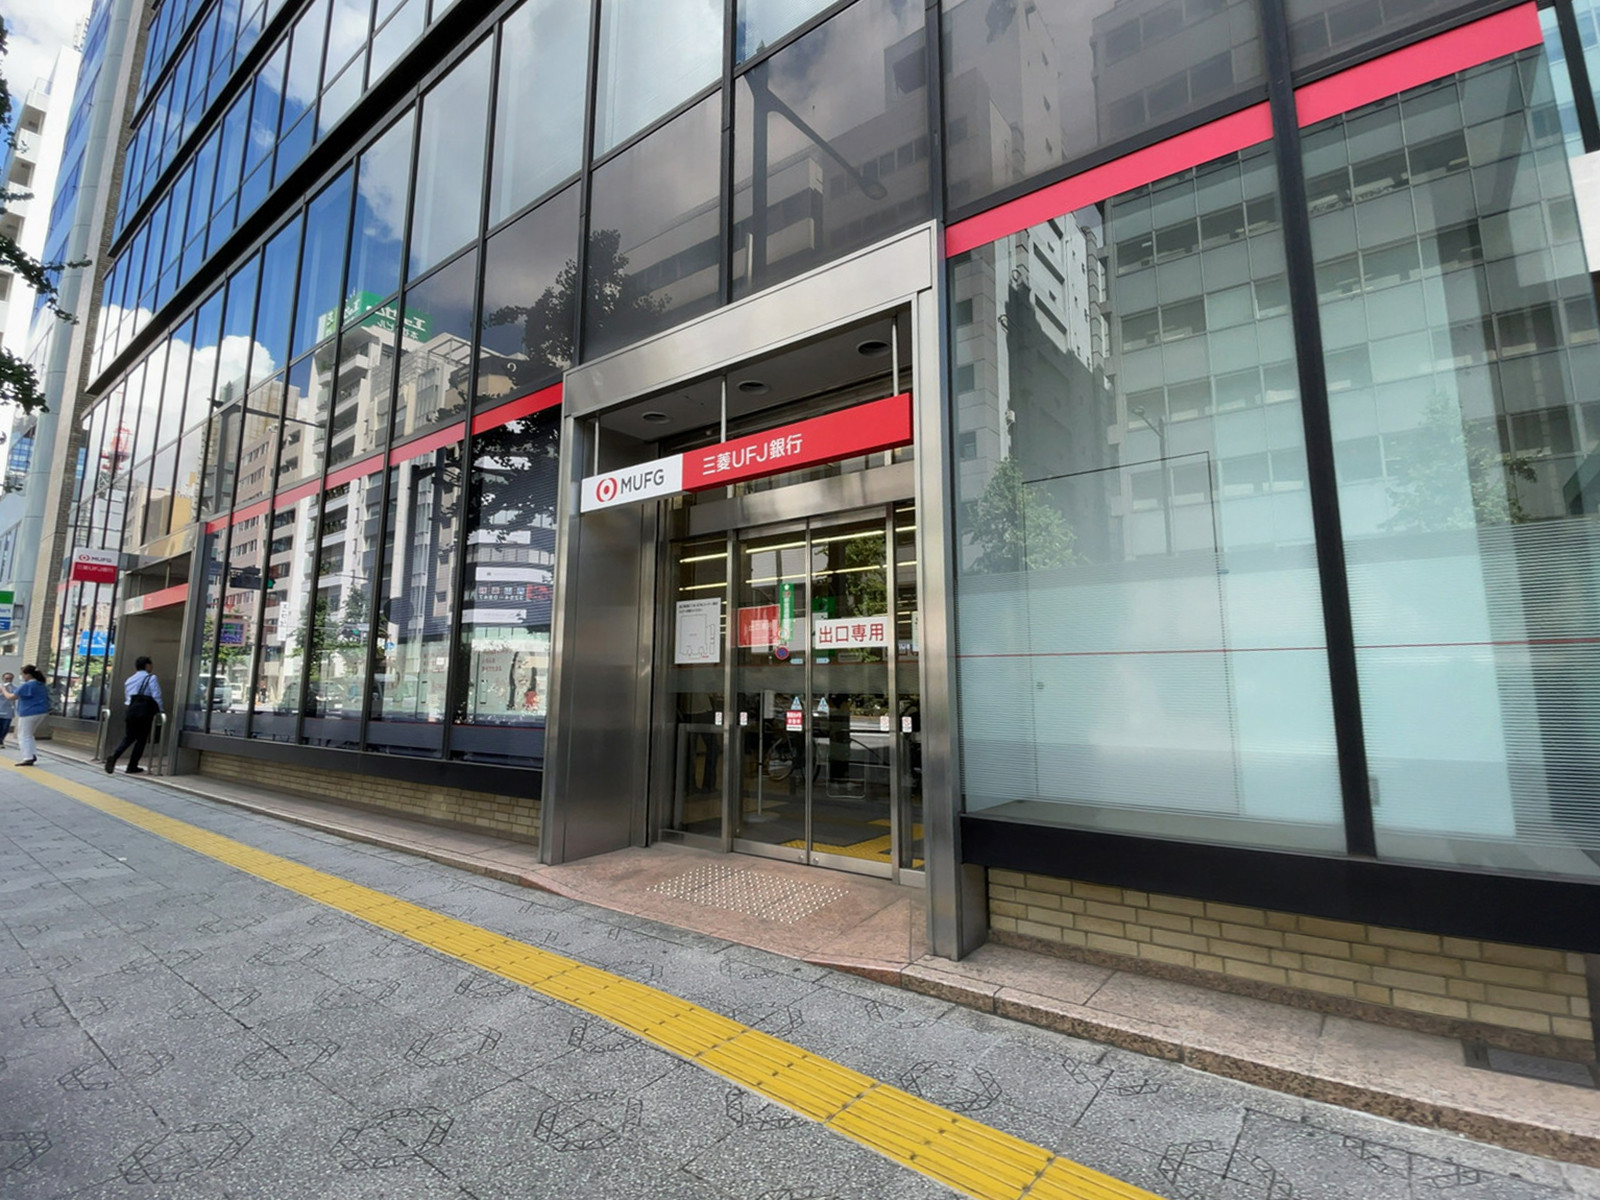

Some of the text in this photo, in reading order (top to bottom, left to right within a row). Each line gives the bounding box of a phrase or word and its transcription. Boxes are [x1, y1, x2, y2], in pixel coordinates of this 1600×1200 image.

[702, 433, 803, 475] 三菱UFJ銀行
[620, 468, 664, 494] MUFG
[819, 623, 884, 643] 出口専用
